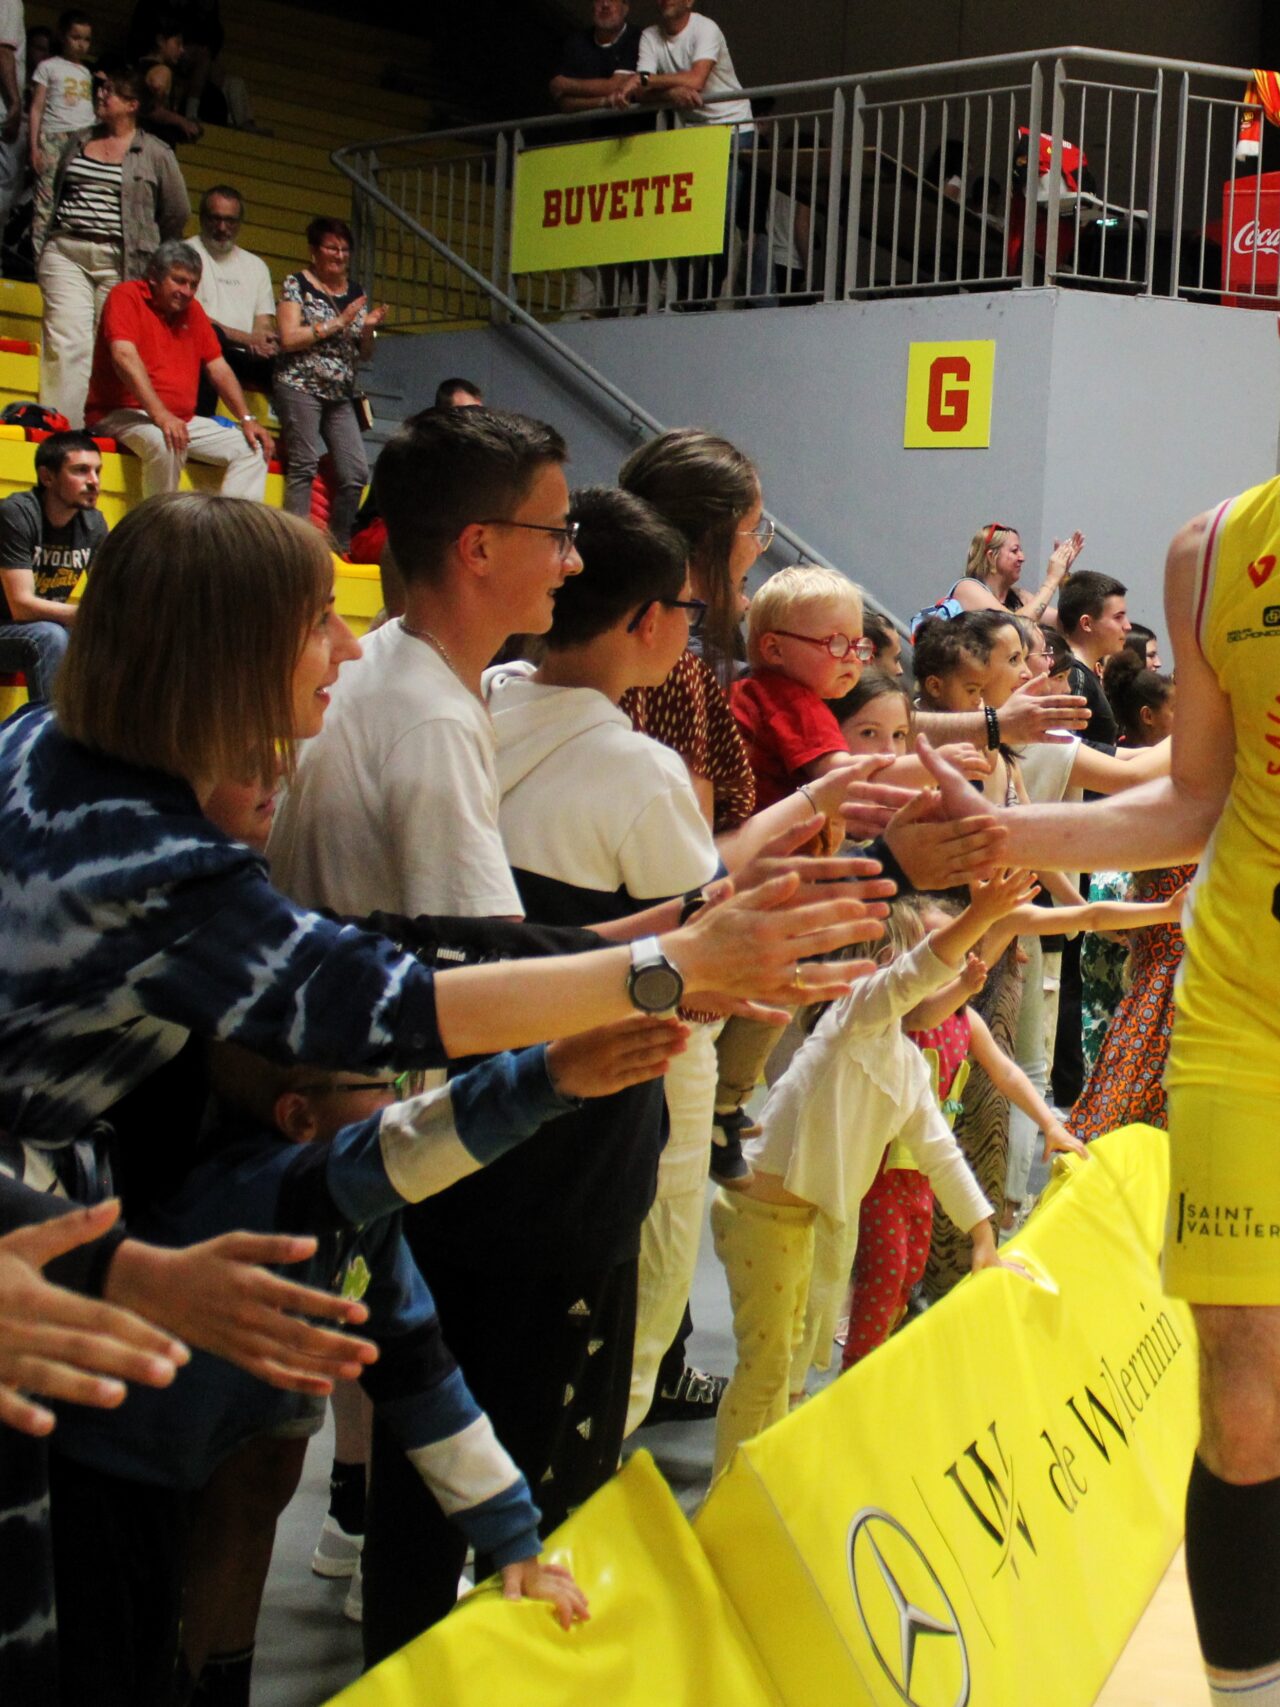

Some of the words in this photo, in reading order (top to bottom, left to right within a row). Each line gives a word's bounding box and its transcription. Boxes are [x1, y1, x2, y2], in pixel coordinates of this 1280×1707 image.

[543, 172, 693, 228] BUVETTE
[927, 356, 971, 432] G
[1187, 1206, 1254, 1220] SAINT
[1187, 1223, 1280, 1239] VALLIER
[1040, 1429, 1088, 1514] de
